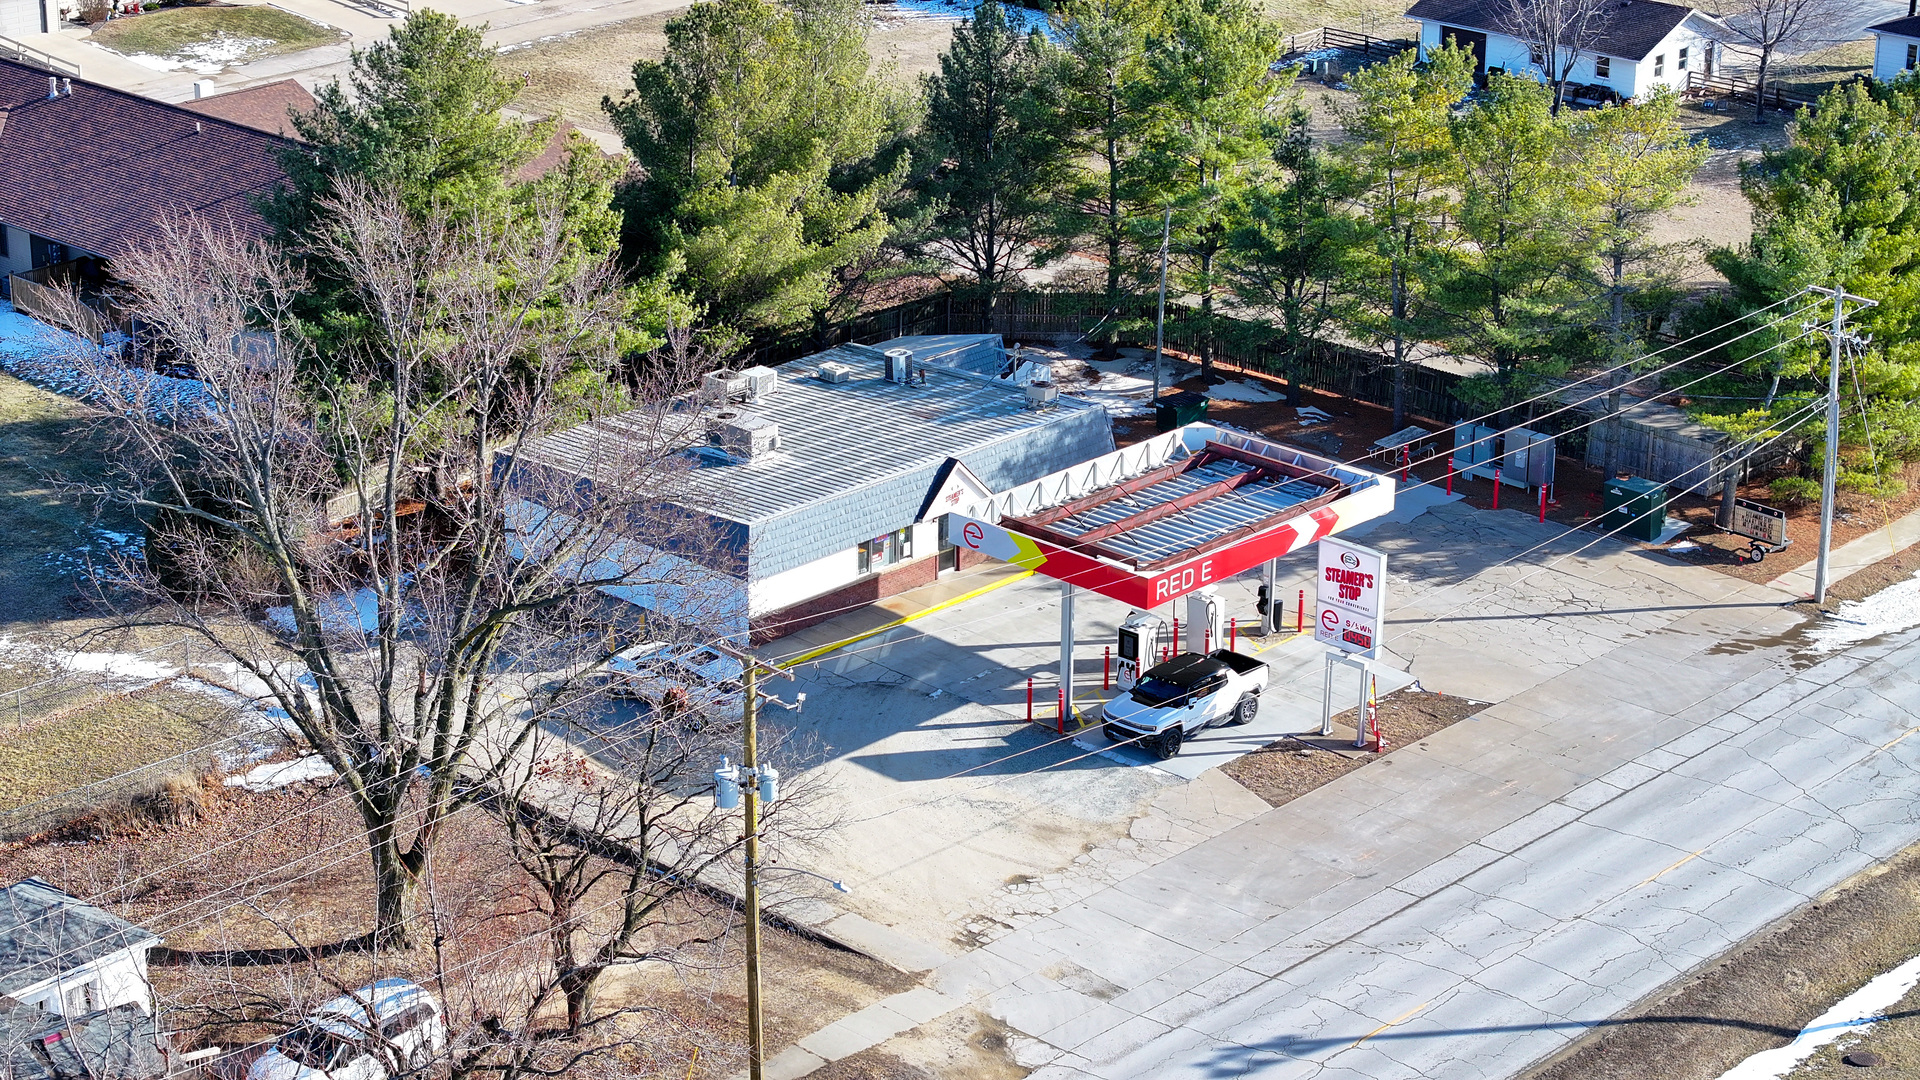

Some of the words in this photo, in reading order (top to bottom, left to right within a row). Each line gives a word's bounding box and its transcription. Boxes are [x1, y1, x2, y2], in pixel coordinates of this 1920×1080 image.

[1156, 568, 1195, 601] RED
[1201, 560, 1213, 582] E
[1325, 567, 1374, 588] STEAMER'S
[1339, 584, 1361, 601] STOP
